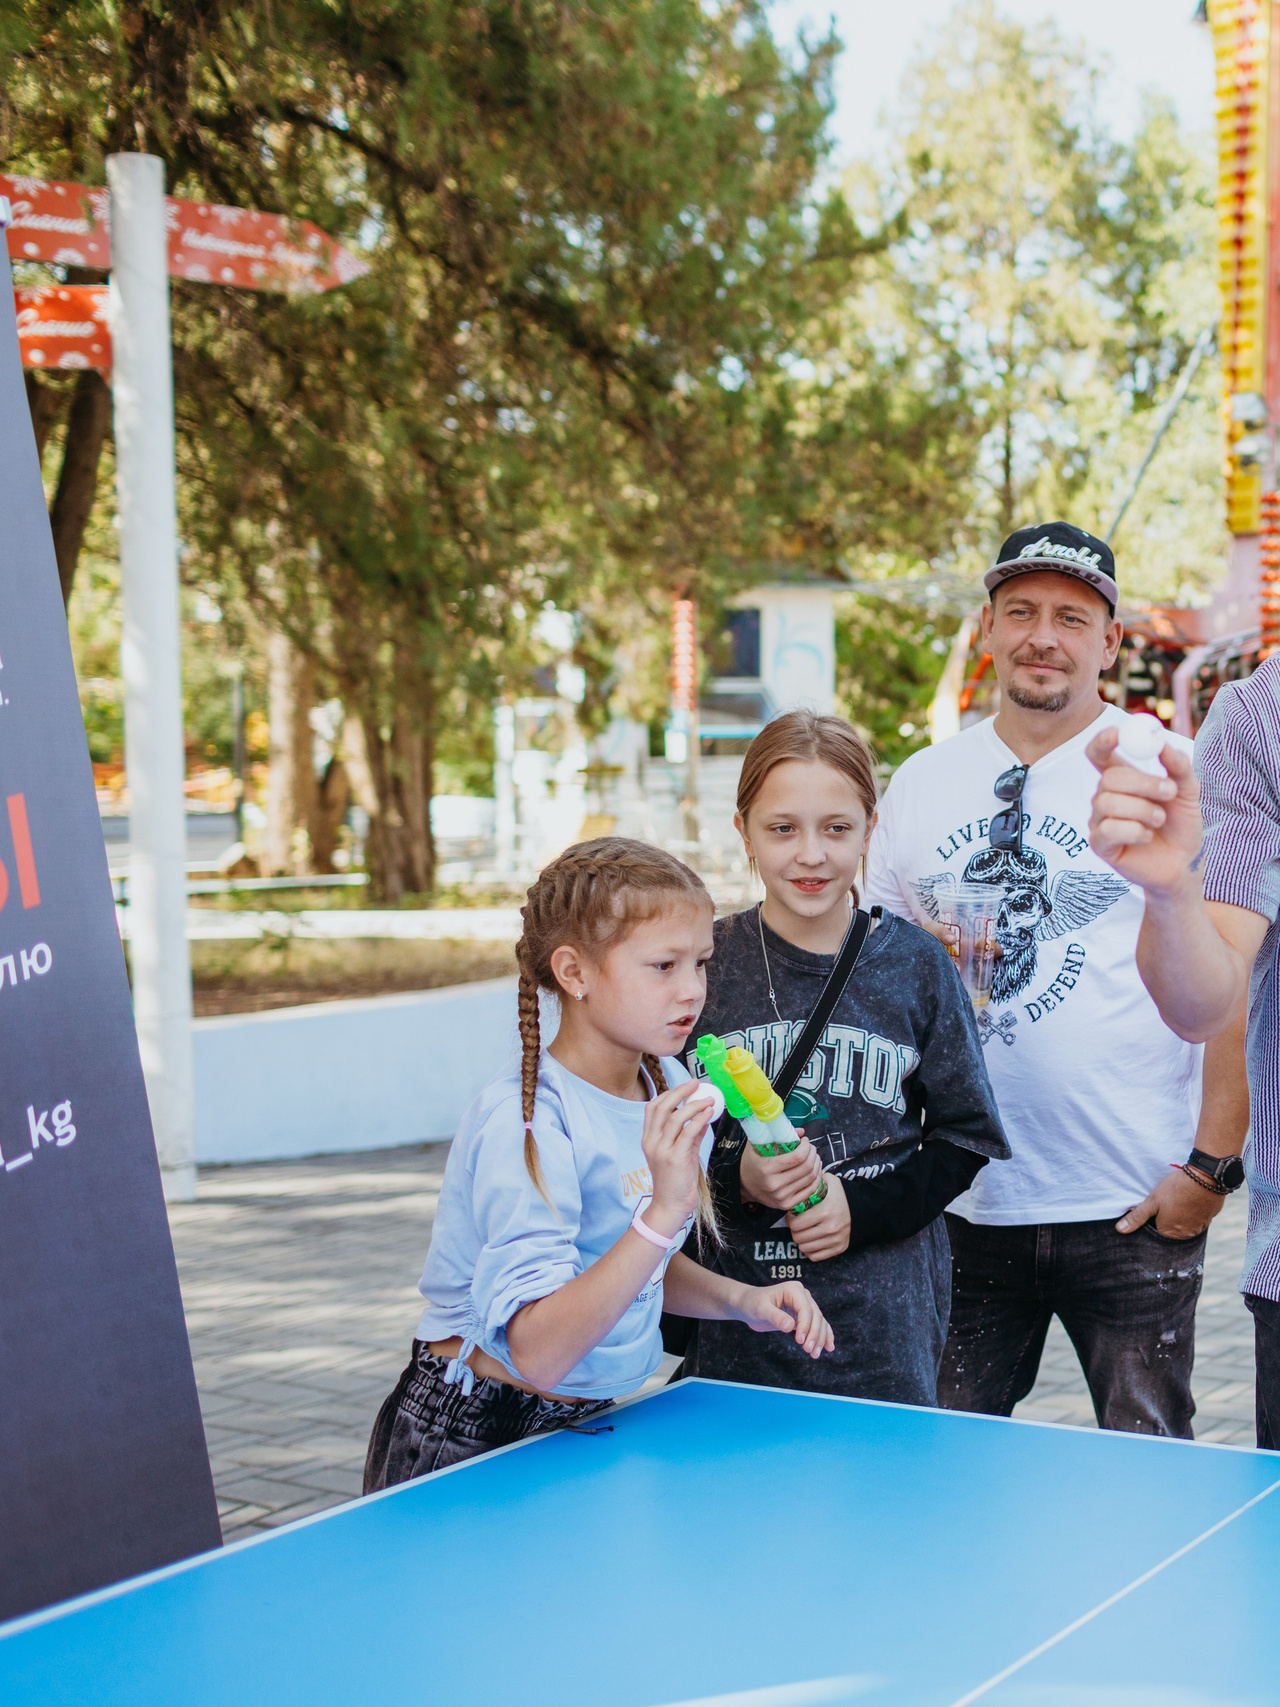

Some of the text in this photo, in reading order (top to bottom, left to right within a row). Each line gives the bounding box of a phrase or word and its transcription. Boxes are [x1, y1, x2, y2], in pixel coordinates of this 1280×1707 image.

[1017, 535, 1103, 570] Arnold
[936, 817, 989, 862] LIVE
[1036, 815, 1089, 858] RIDE
[1024, 942, 1086, 1023] DEFEND
[0, 1100, 77, 1171] _kg
[754, 1241, 807, 1261] LEAG
[771, 1265, 802, 1279] 1991
